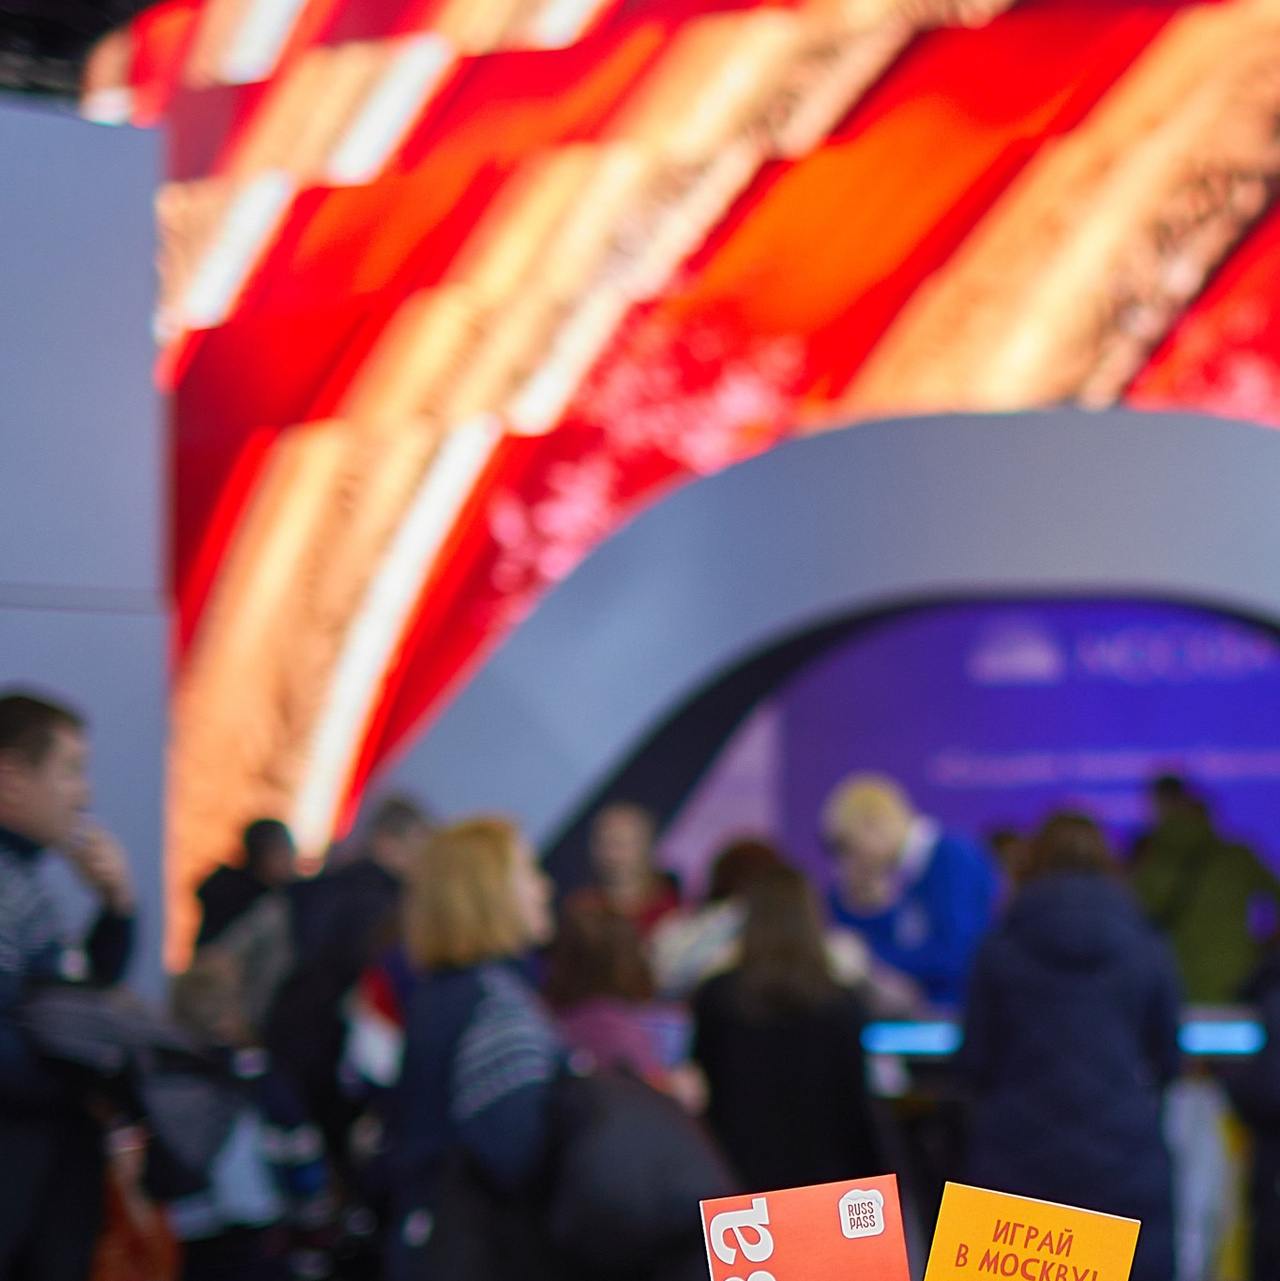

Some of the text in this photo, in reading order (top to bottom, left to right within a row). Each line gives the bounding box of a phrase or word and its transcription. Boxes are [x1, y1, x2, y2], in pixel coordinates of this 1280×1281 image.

[847, 1201, 874, 1217] RUSS
[849, 1215, 876, 1230] PASS
[992, 1219, 1074, 1257] ИГРАЙ
[955, 1243, 969, 1267] В
